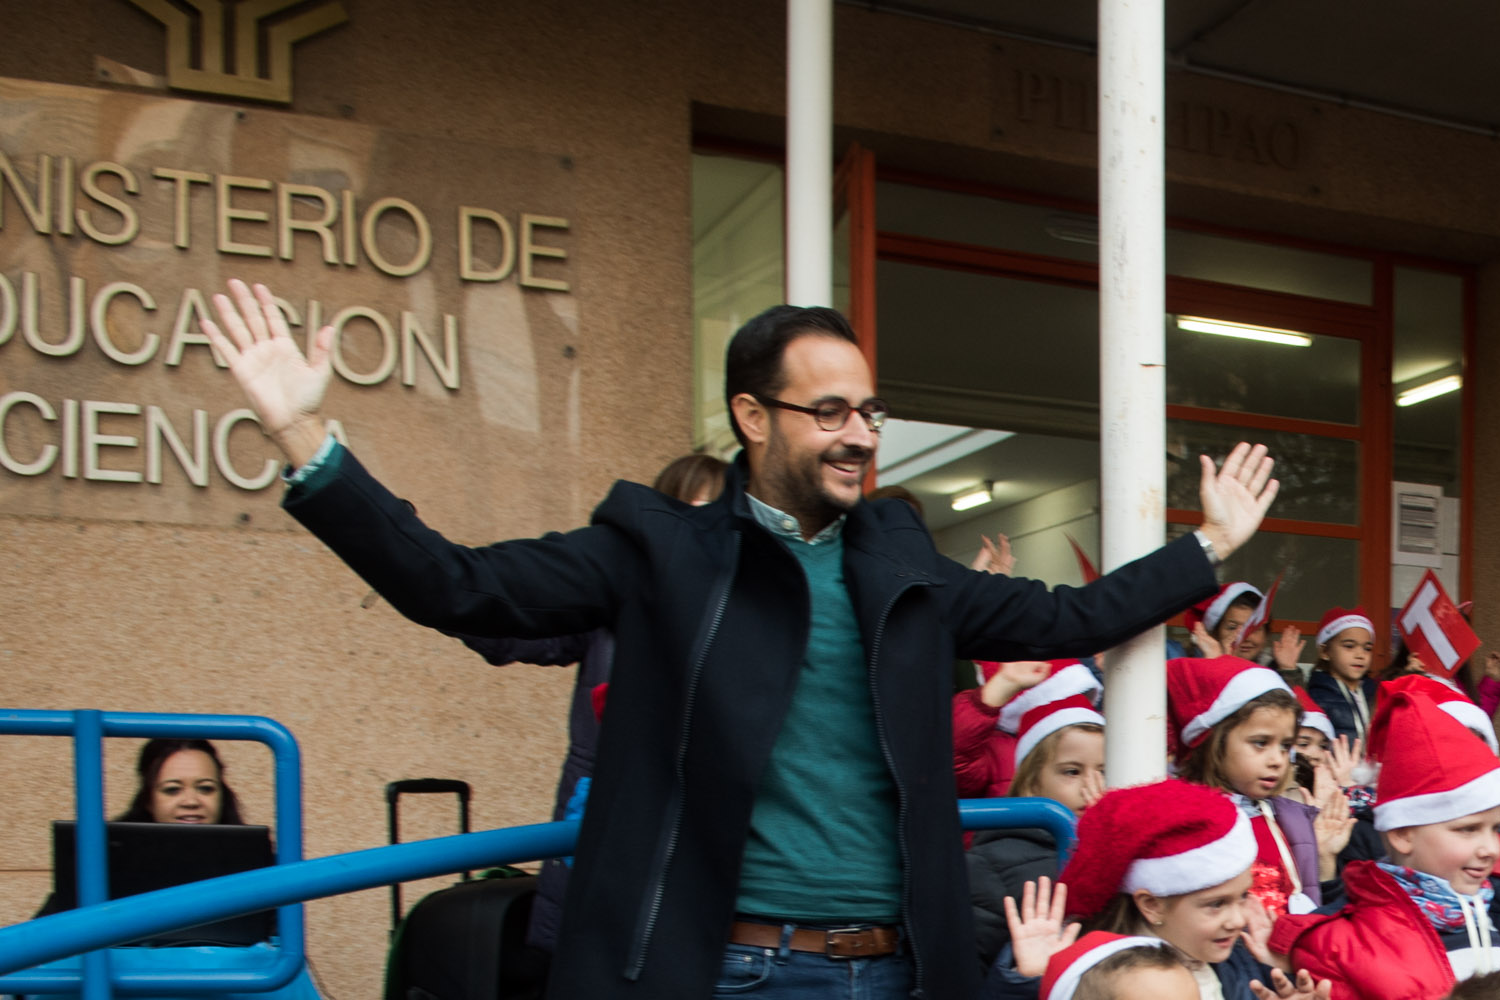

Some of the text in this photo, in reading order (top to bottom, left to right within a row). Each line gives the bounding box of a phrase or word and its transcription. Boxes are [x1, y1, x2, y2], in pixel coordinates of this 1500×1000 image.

[458, 205, 571, 292] DE
[0, 272, 461, 389] UCAION
[1400, 579, 1460, 671] T
